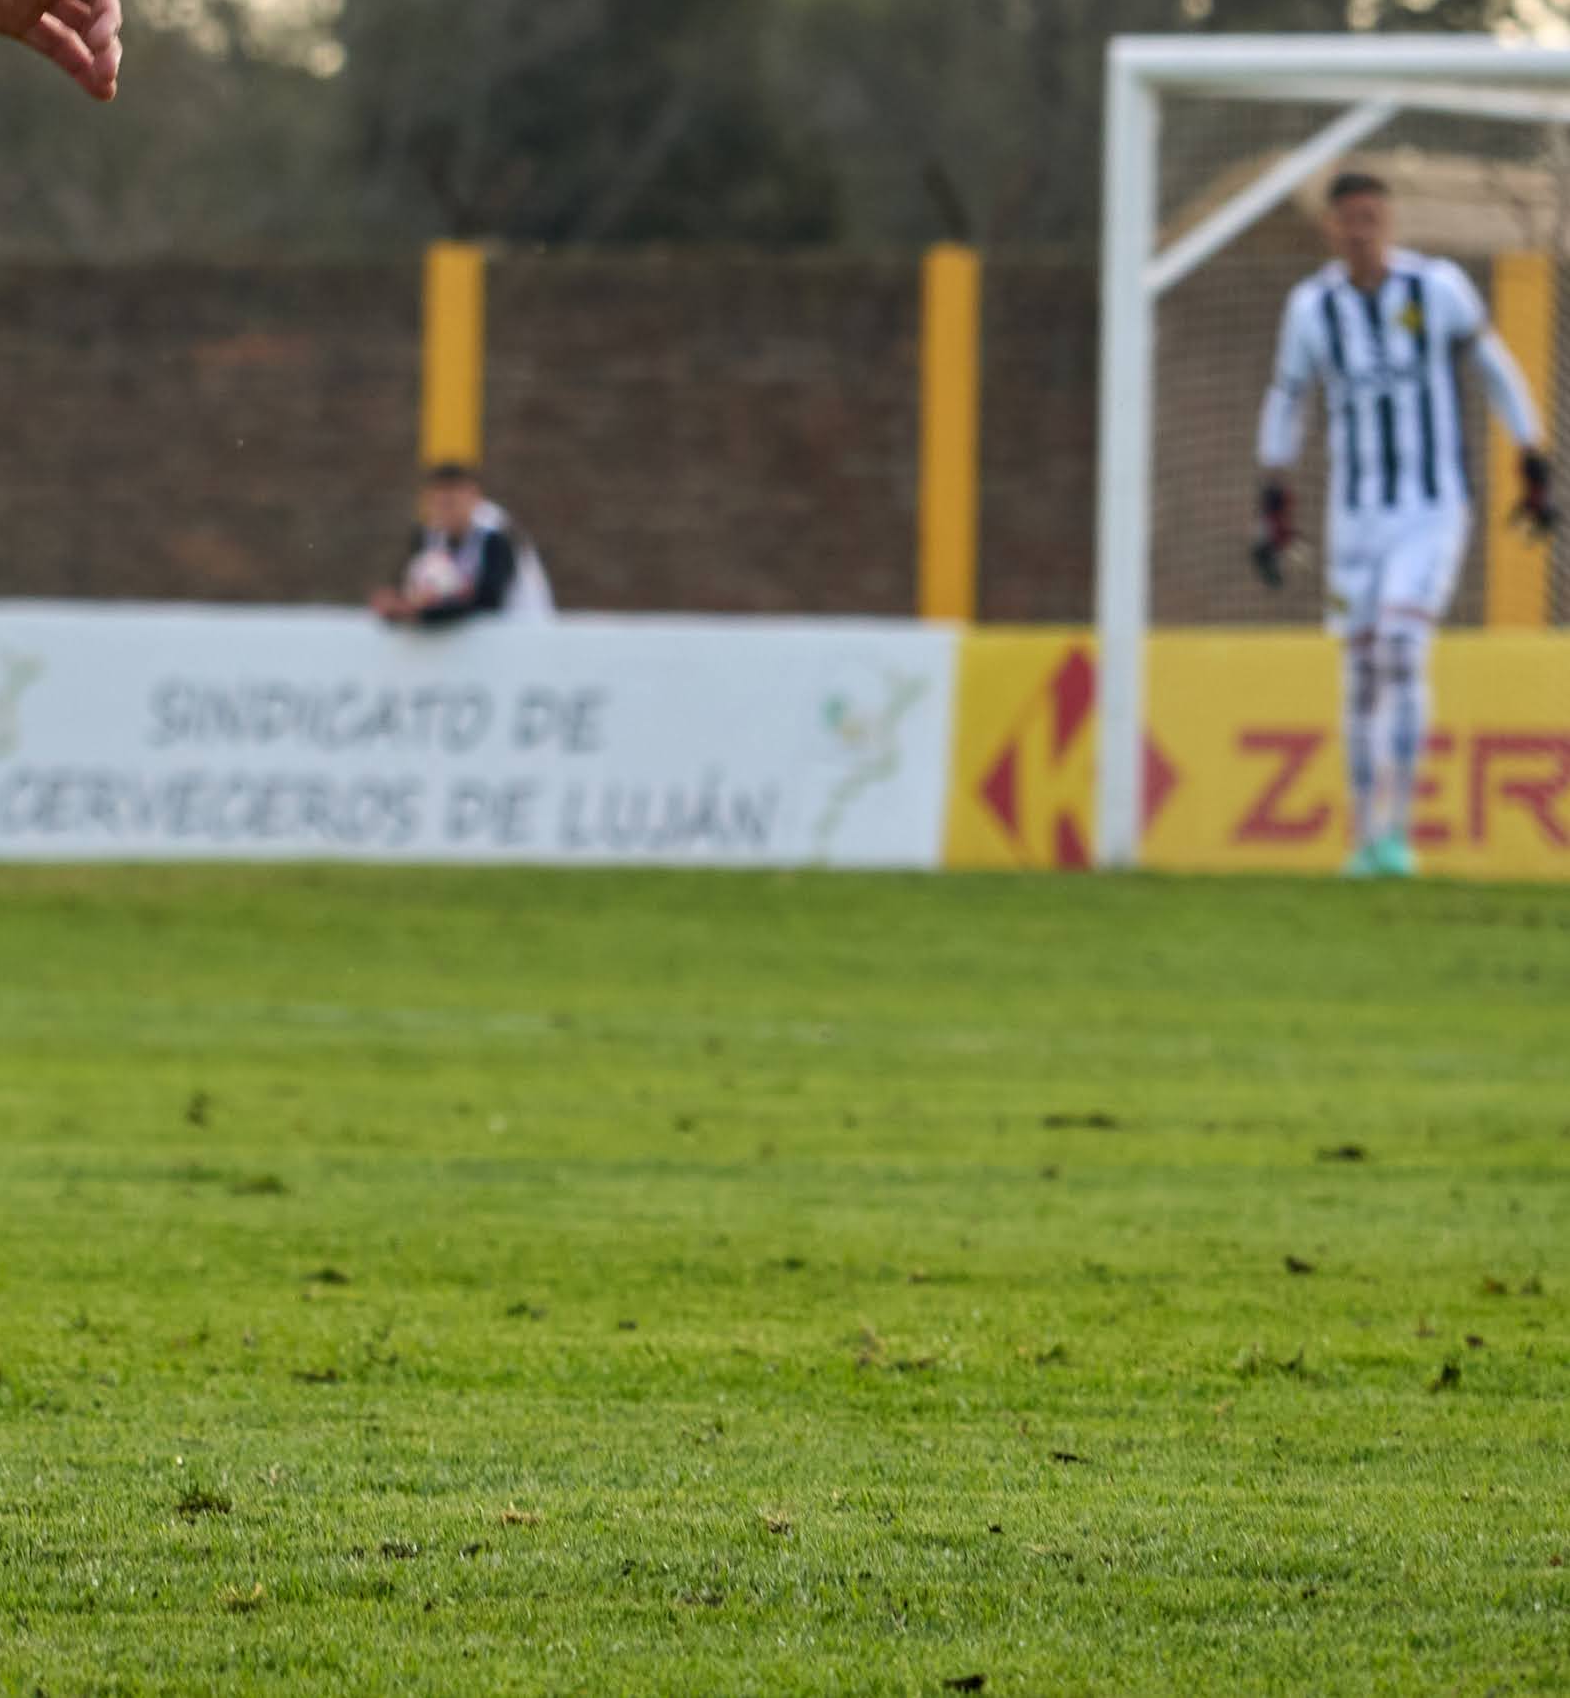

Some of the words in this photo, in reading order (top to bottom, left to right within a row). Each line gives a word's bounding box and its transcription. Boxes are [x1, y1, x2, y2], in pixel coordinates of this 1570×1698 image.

[145, 677, 493, 753] SINDICATO
[511, 683, 611, 755] DE
[445, 774, 541, 846] DE
[562, 762, 783, 852] LUJÁN
